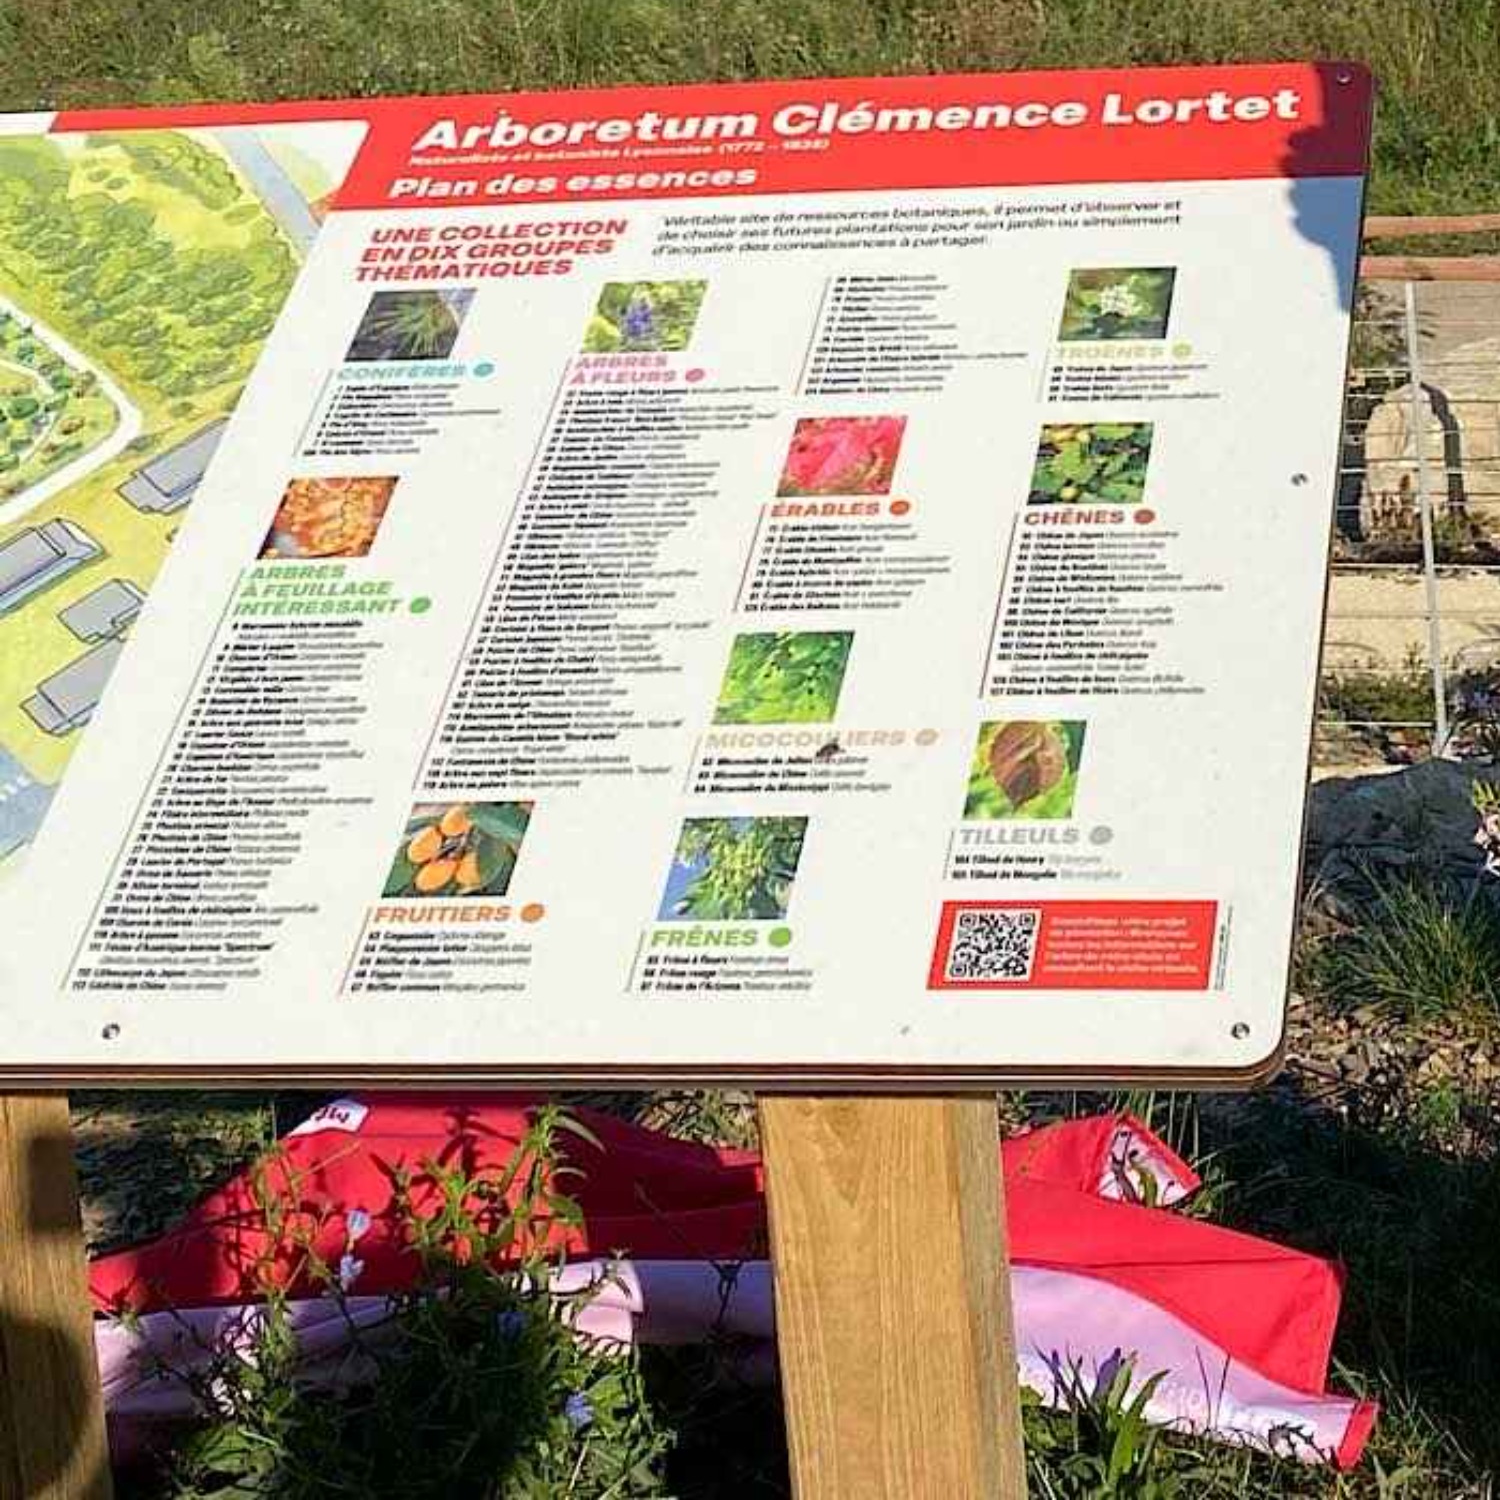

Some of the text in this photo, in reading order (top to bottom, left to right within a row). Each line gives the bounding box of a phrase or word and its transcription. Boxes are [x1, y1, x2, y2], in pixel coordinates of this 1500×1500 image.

[411, 88, 1300, 152] Arboretum Clémence Lortet
[388, 167, 757, 200] Plan des essences
[371, 218, 629, 245] UNE COLLECTION
[361, 238, 616, 264] EN DIX GROUPES
[959, 826, 1081, 846] TILLEULS
[373, 904, 513, 924] FRUITIERS
